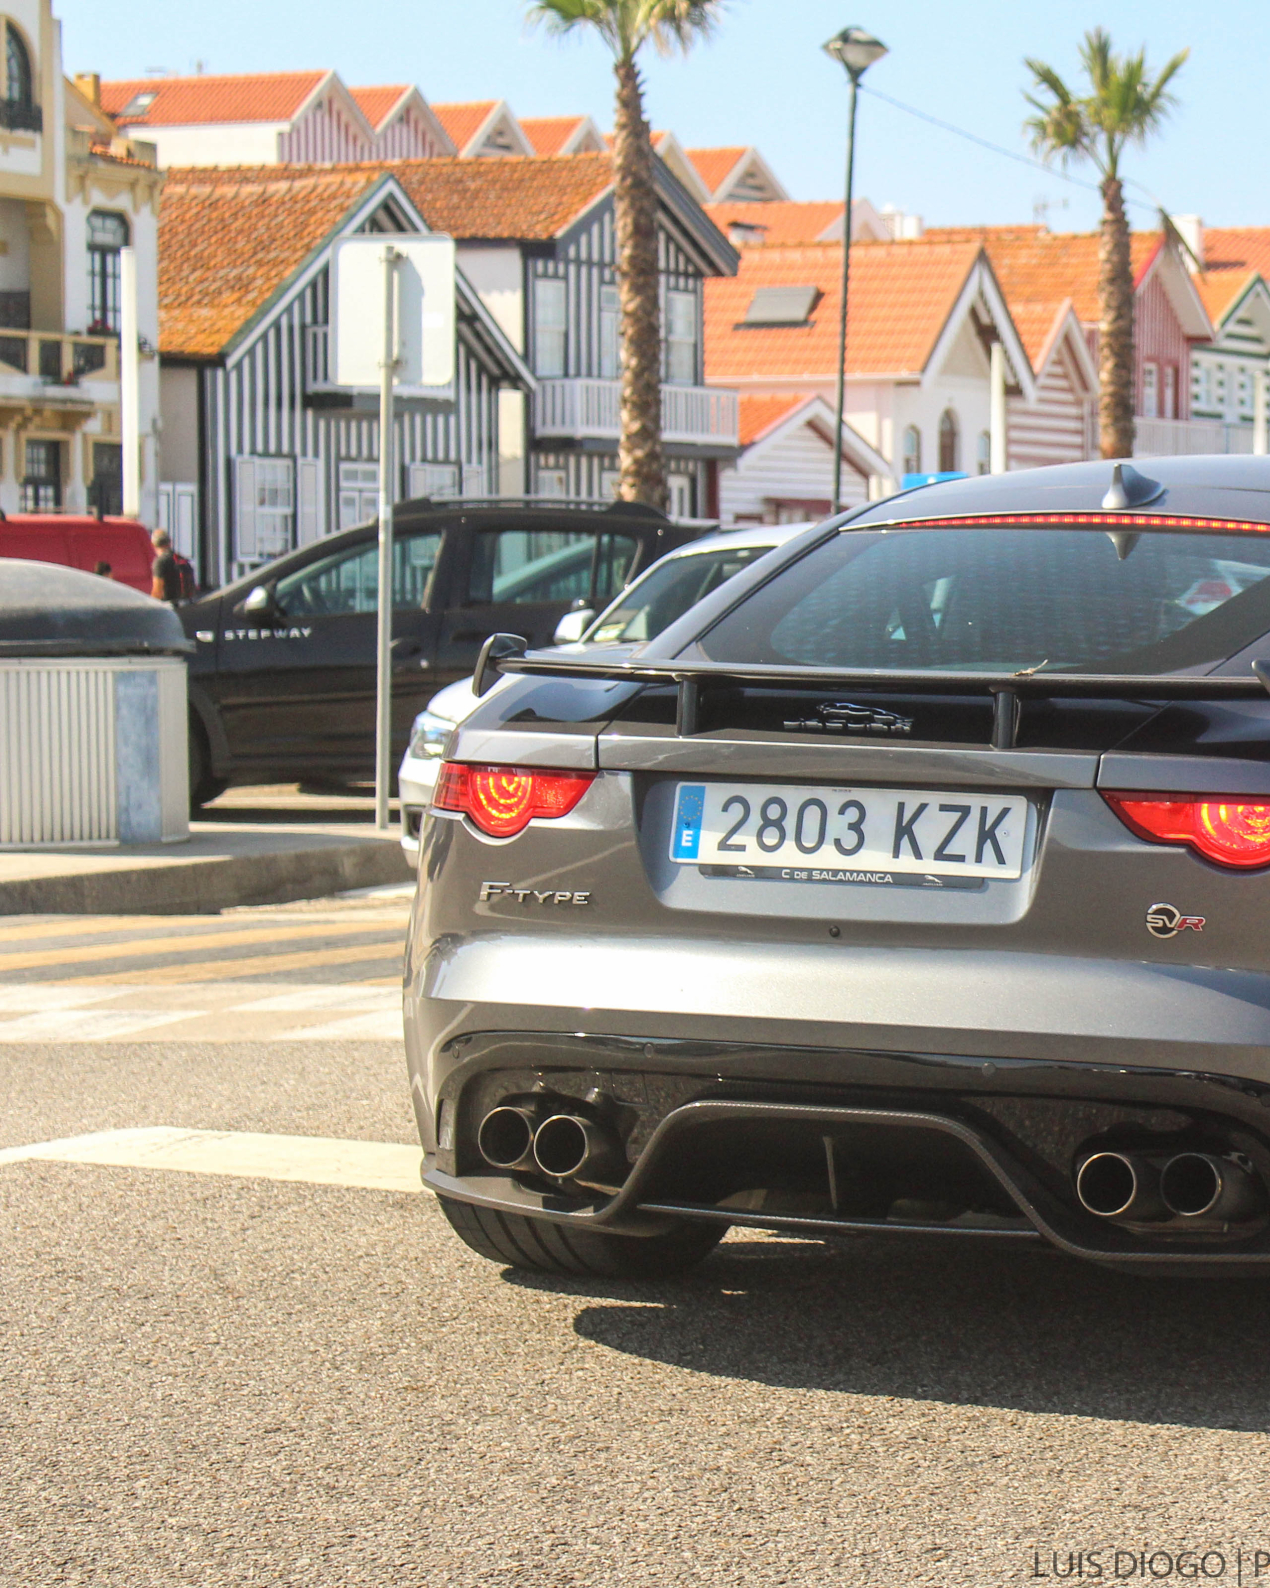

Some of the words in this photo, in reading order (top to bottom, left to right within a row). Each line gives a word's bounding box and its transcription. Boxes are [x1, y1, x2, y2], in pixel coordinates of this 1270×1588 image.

[224, 627, 312, 641] STEPWAY
[681, 830, 694, 846] E
[717, 795, 866, 856] 2803
[892, 801, 1012, 865] KZK
[781, 868, 791, 878] C
[812, 870, 893, 883] SALAMANCA
[479, 881, 591, 905] F-TYPE
[1146, 906, 1205, 935] SVR
